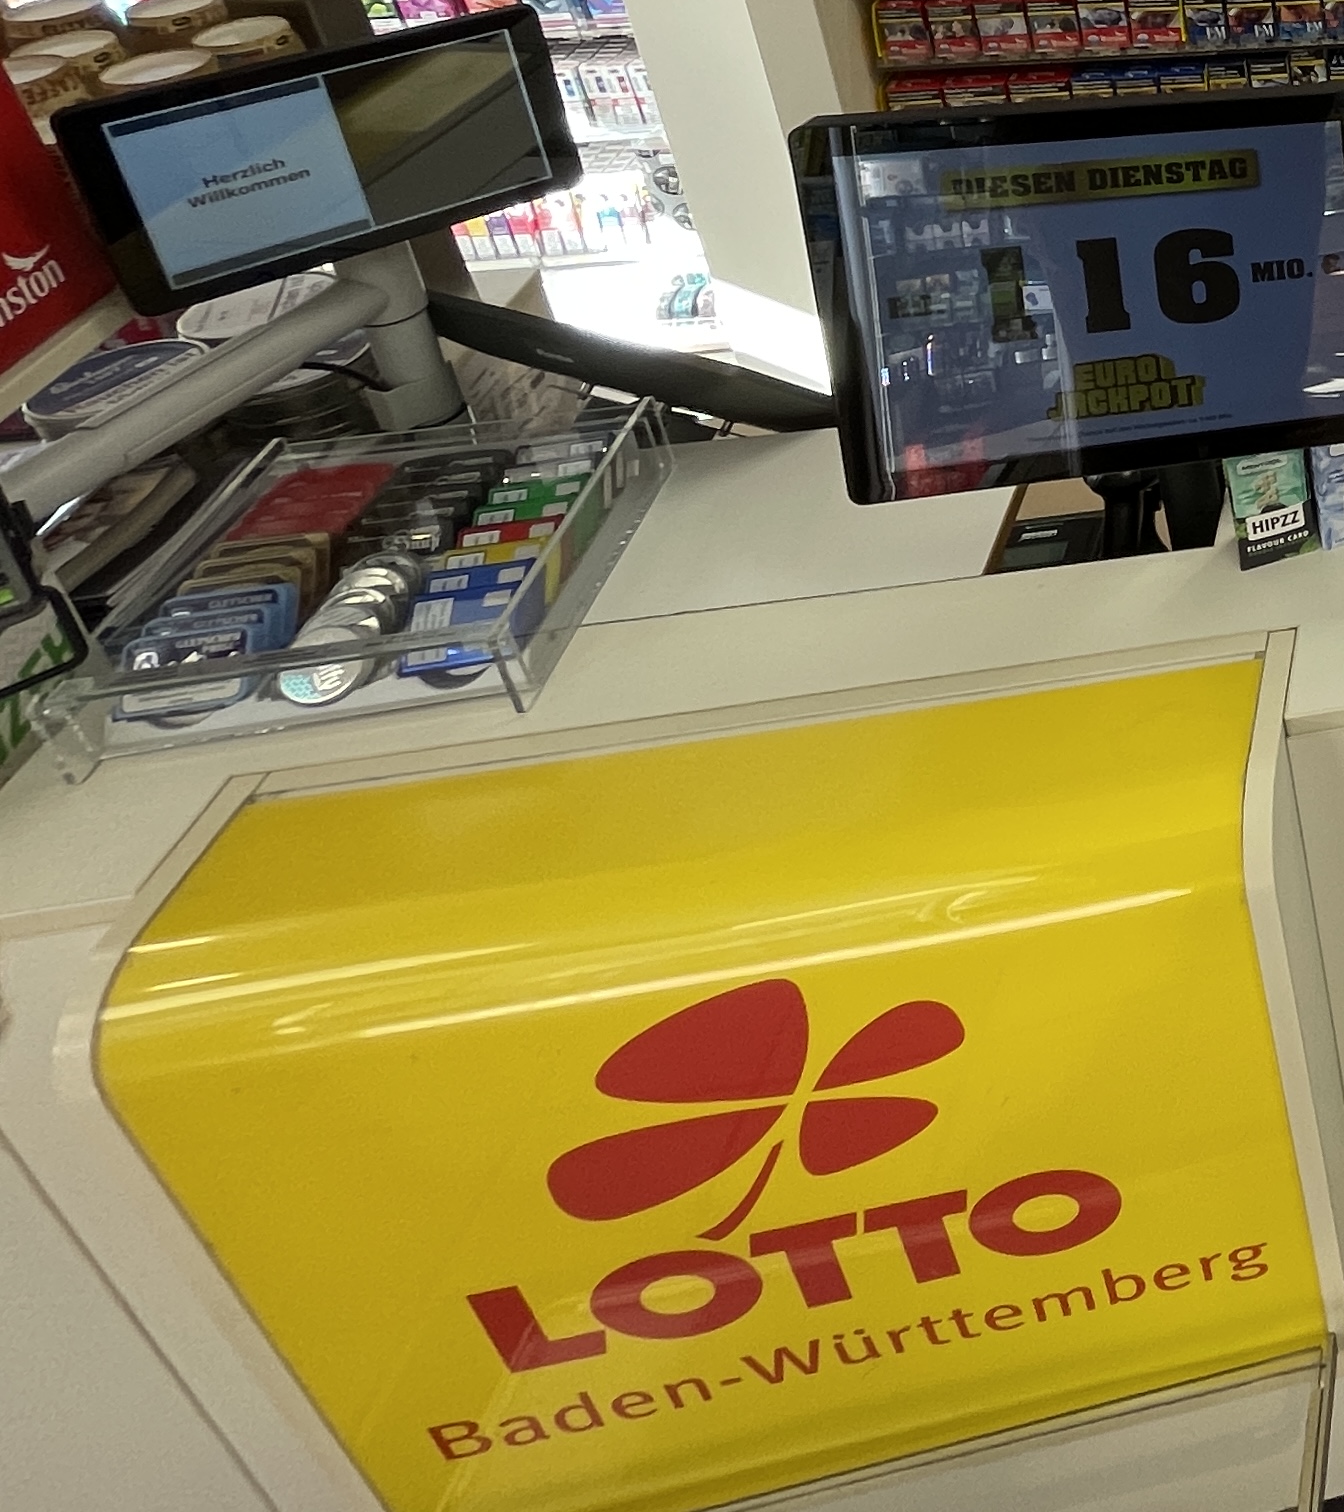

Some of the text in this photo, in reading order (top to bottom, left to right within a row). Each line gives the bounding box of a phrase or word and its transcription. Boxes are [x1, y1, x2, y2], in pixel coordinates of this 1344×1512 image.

[187, 166, 311, 209] Willkommen
[202, 157, 286, 188] Herzlich
[951, 157, 1248, 200] DIESEN DIENSTAG
[1251, 258, 1313, 284] MIO.
[1074, 355, 1159, 392] EURO
[1250, 510, 1301, 537] HIPZZ
[466, 1170, 1123, 1374] LOTTO
[426, 1240, 1272, 1462] Baden-Württemberg
